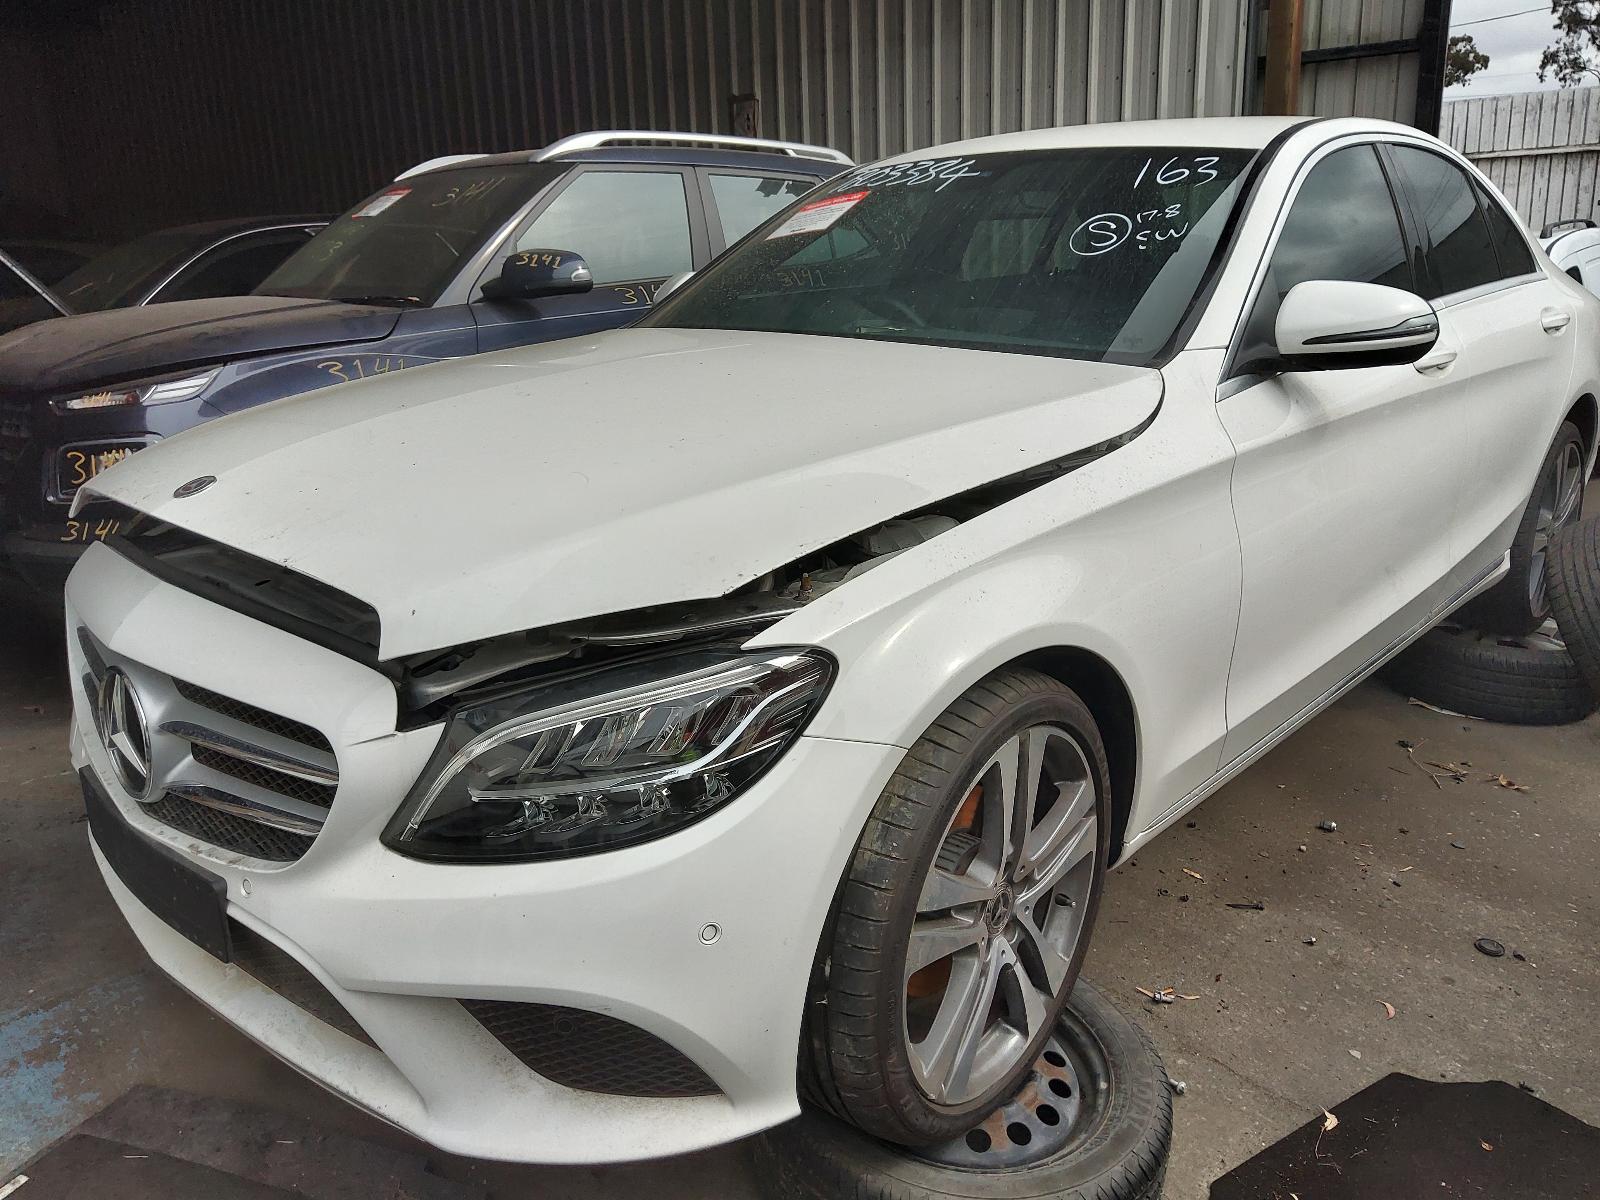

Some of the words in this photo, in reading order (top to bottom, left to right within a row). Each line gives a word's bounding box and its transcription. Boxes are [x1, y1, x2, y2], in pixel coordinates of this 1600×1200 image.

[1133, 156, 1220, 189] 163
[516, 253, 561, 269] 3141
[317, 358, 404, 381] 3141
[61, 519, 119, 541] 3141
